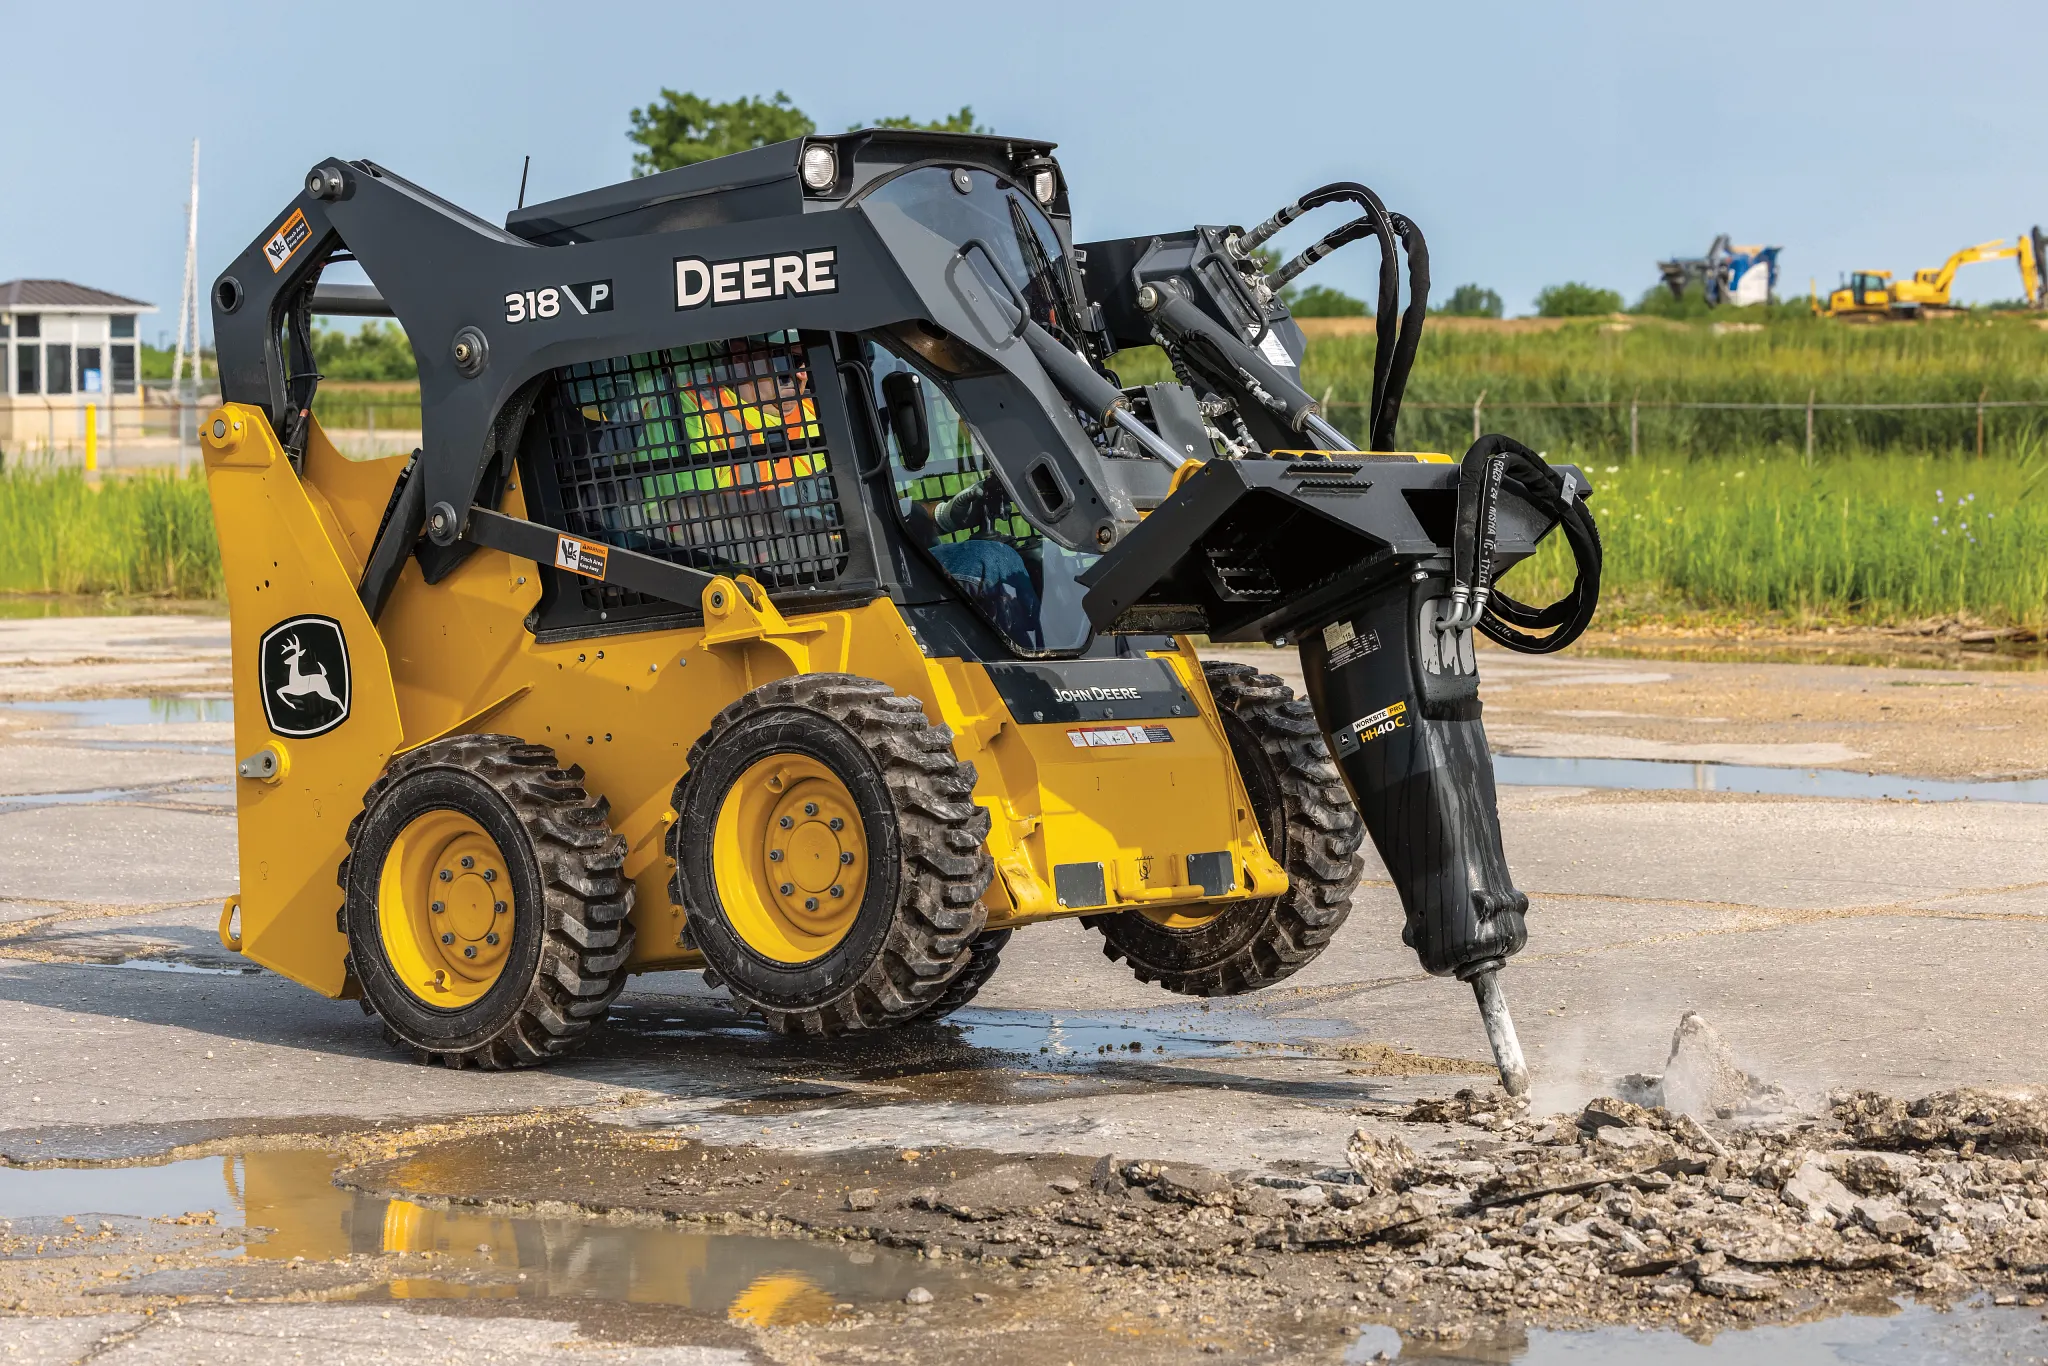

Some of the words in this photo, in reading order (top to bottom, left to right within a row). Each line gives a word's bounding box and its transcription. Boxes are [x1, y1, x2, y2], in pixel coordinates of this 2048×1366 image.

[676, 251, 836, 307] DEERE
[1488, 505, 1497, 535] MSHA
[580, 555, 593, 564] Pinch
[593, 559, 603, 567] Area
[1054, 688, 1094, 702] JOHN
[1090, 686, 1142, 701] DEERE
[1354, 710, 1387, 730] WORKSITE
[1389, 704, 1404, 715] PRO
[1360, 715, 1405, 743] HH40C
